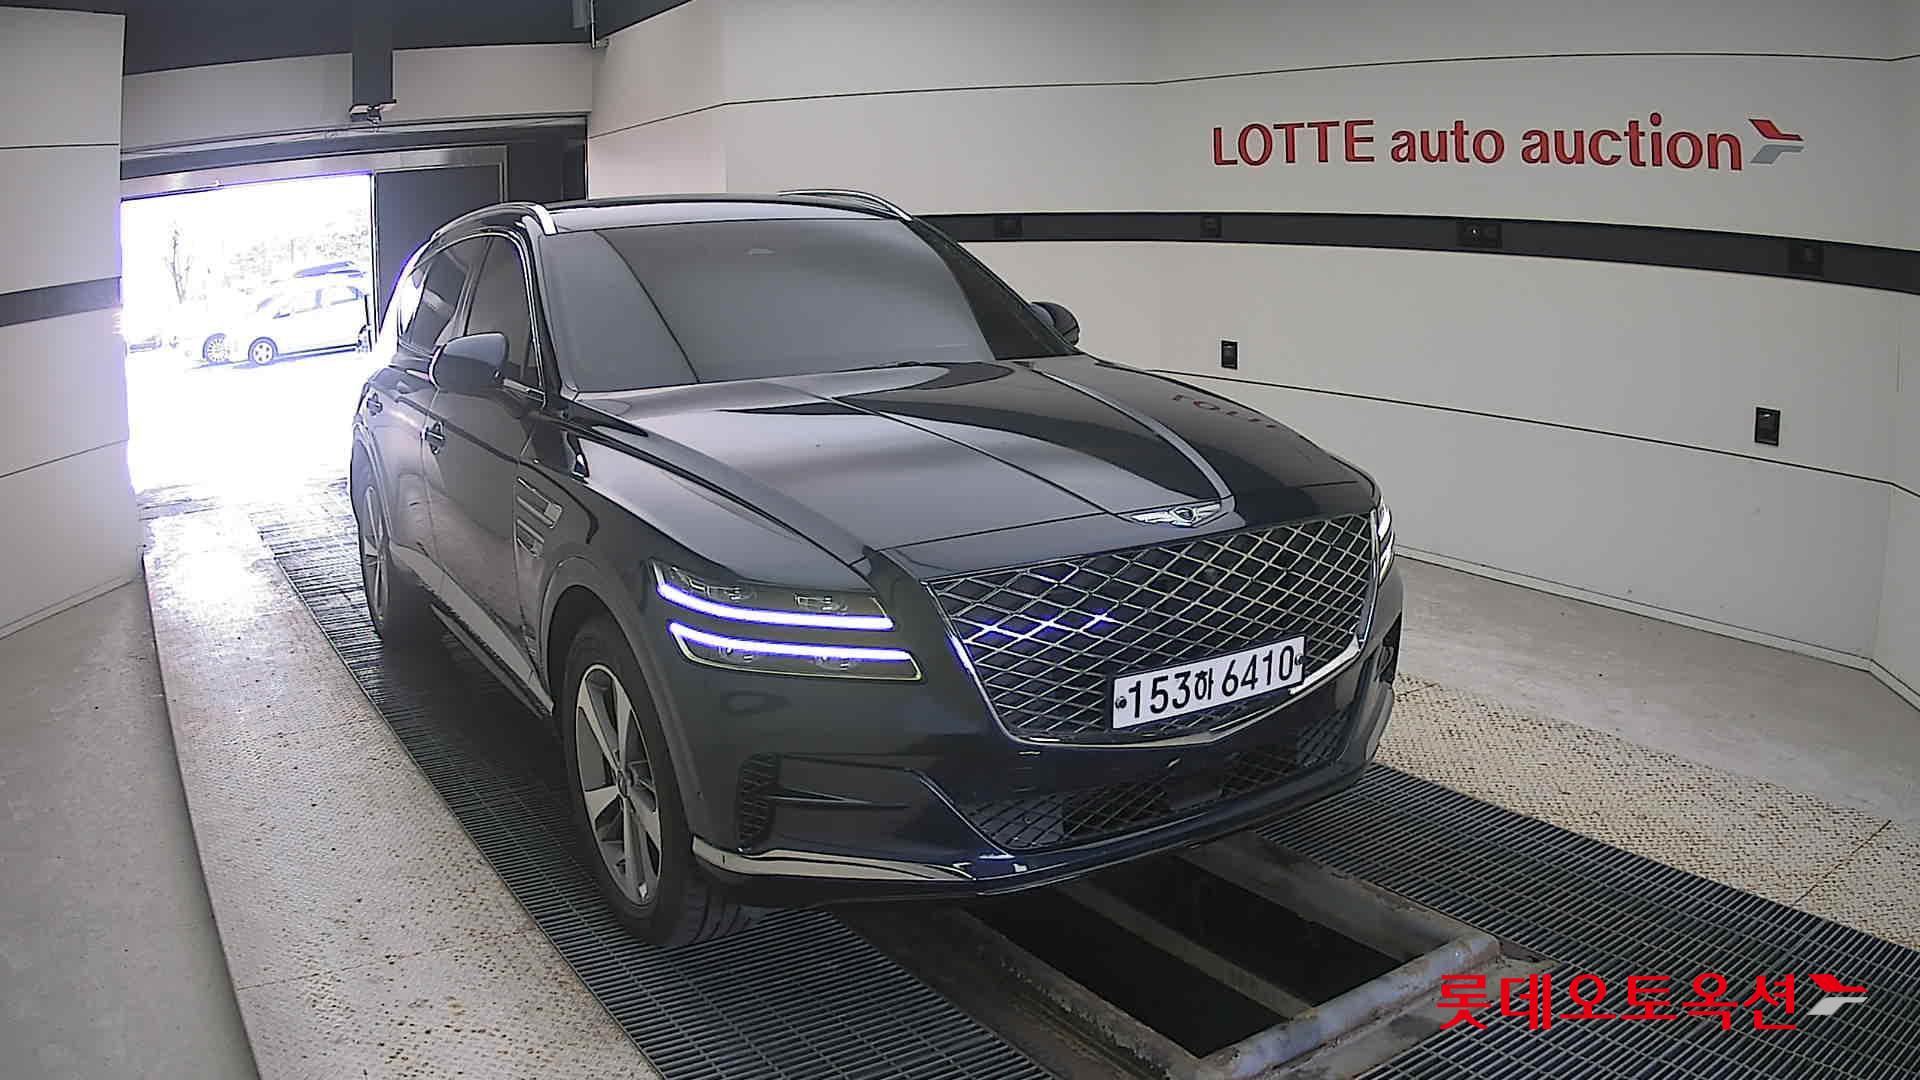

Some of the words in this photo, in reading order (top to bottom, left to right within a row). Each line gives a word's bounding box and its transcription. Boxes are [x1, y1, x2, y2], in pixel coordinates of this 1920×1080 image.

[1213, 119, 1375, 166] LOTTE
[1390, 119, 1505, 164] auto
[1521, 112, 1743, 171] auction
[1128, 667, 1214, 719] 153하
[1221, 645, 1295, 697] 6410
